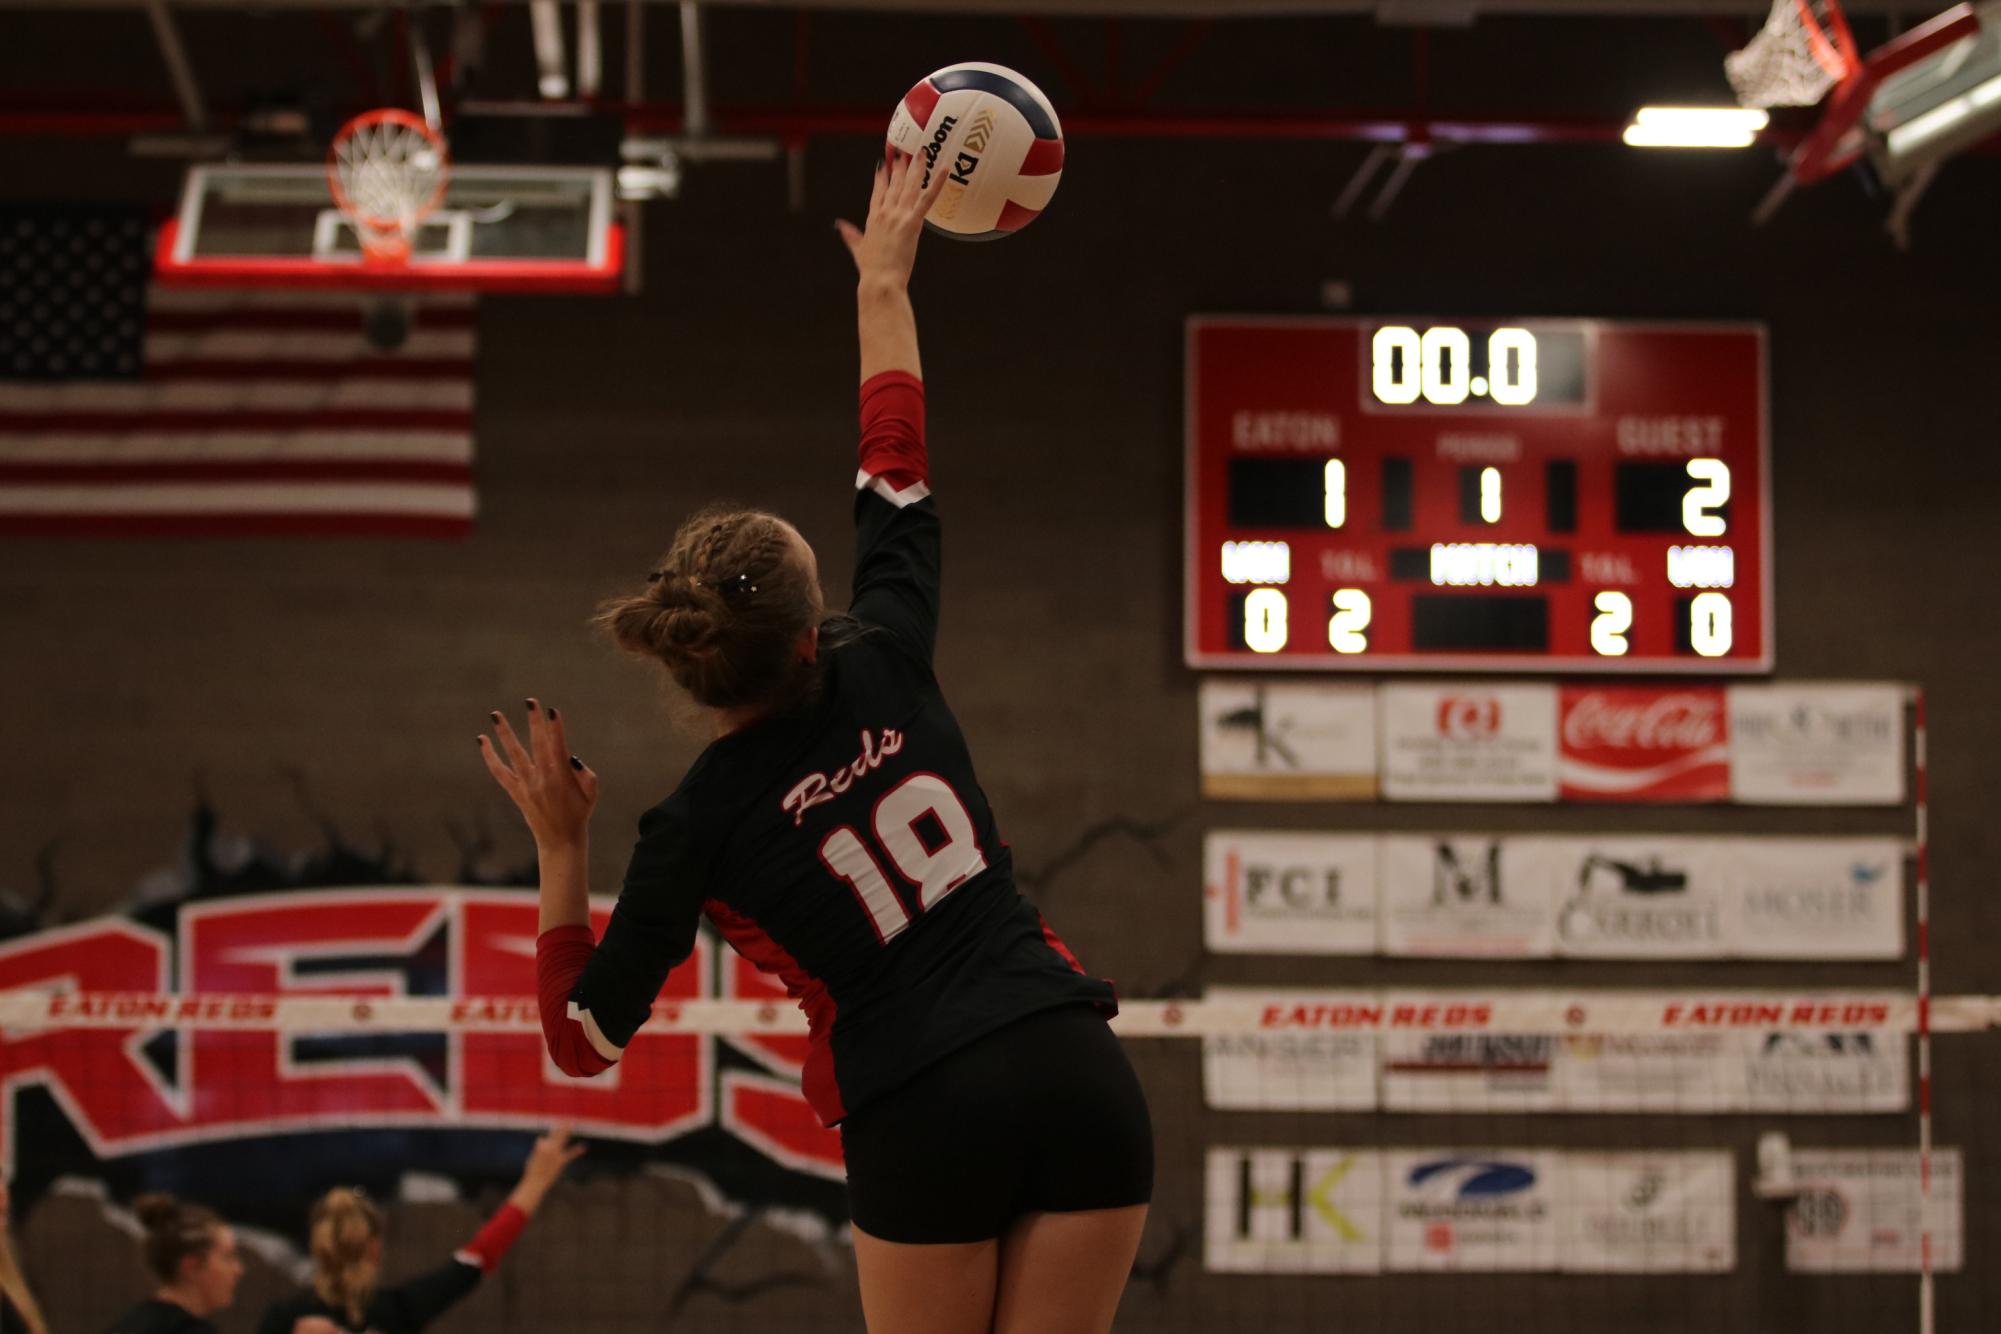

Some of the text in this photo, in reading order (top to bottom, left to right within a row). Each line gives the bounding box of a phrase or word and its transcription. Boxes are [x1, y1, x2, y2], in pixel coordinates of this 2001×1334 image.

[1373, 326, 1537, 405] 00.0
[1233, 415, 1339, 447] EATON
[1616, 418, 1724, 453] GUEST
[1324, 458, 1346, 529] 1
[1480, 466, 1502, 524] 1
[1682, 458, 1731, 536] 2
[1244, 587, 1288, 653] 0
[1328, 588, 1371, 653] 2
[1590, 591, 1633, 656] 2
[1690, 592, 1732, 657] 0
[781, 727, 903, 827] Reds
[817, 769, 992, 948] 18
[47, 993, 165, 1017] EATON
[449, 1001, 541, 1024] EATO
[1261, 1005, 1491, 1029] EATON REDS
[1661, 1004, 1890, 1027] EATON REDS
